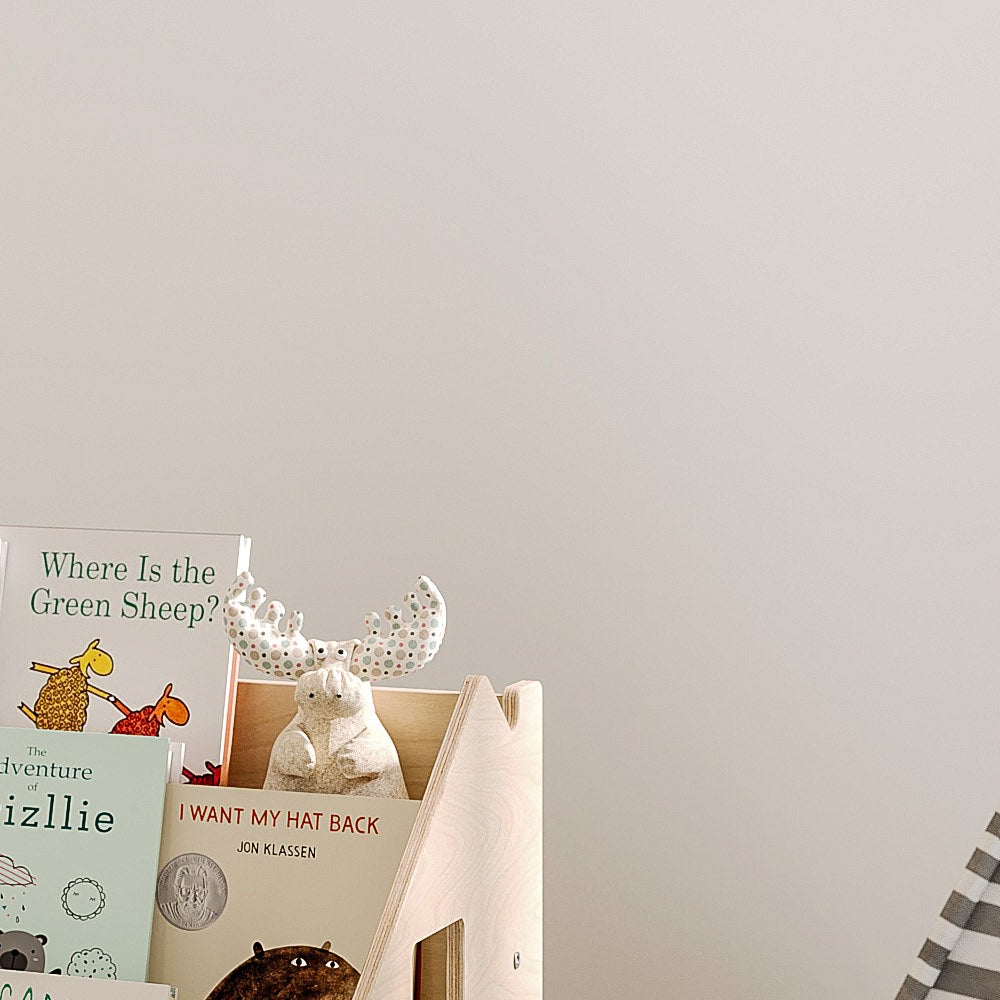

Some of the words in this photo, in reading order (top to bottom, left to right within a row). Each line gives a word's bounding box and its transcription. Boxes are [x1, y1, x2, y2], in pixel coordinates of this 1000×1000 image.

[41, 551, 128, 581] Where
[136, 554, 162, 583] Is
[172, 556, 216, 585] the
[30, 587, 112, 618] Green
[121, 591, 220, 629] Sheep?
[26, 746, 47, 757] The
[27, 781, 39, 792] of
[179, 803, 184, 820] I
[190, 804, 244, 825] WANT
[251, 809, 281, 827] MY
[286, 811, 323, 830] HAT
[329, 814, 380, 835] BACK
[236, 841, 259, 854] JON
[263, 843, 317, 858] KLASSEN
